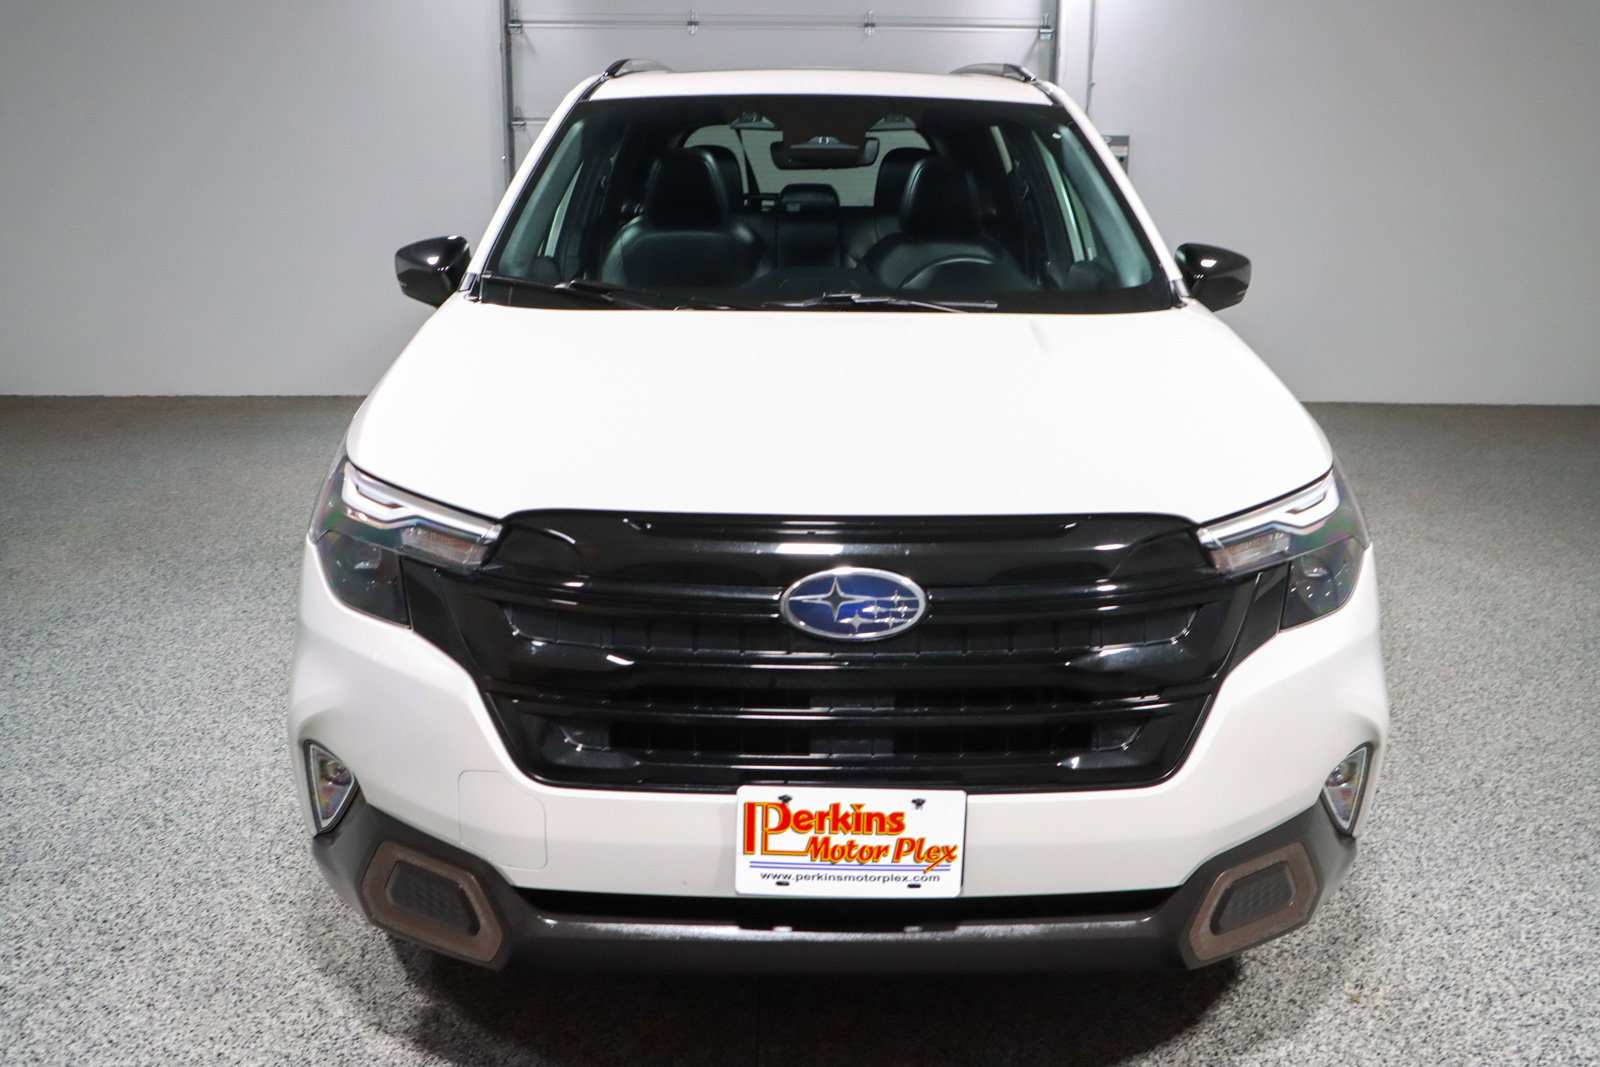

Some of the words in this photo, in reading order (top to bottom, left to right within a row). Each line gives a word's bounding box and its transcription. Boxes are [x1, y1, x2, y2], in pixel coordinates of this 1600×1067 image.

[743, 801, 906, 854] Perkins
[806, 836, 890, 864] Motor
[892, 837, 958, 873] Plex
[760, 871, 940, 883] www.perkinsmotorplex.com
